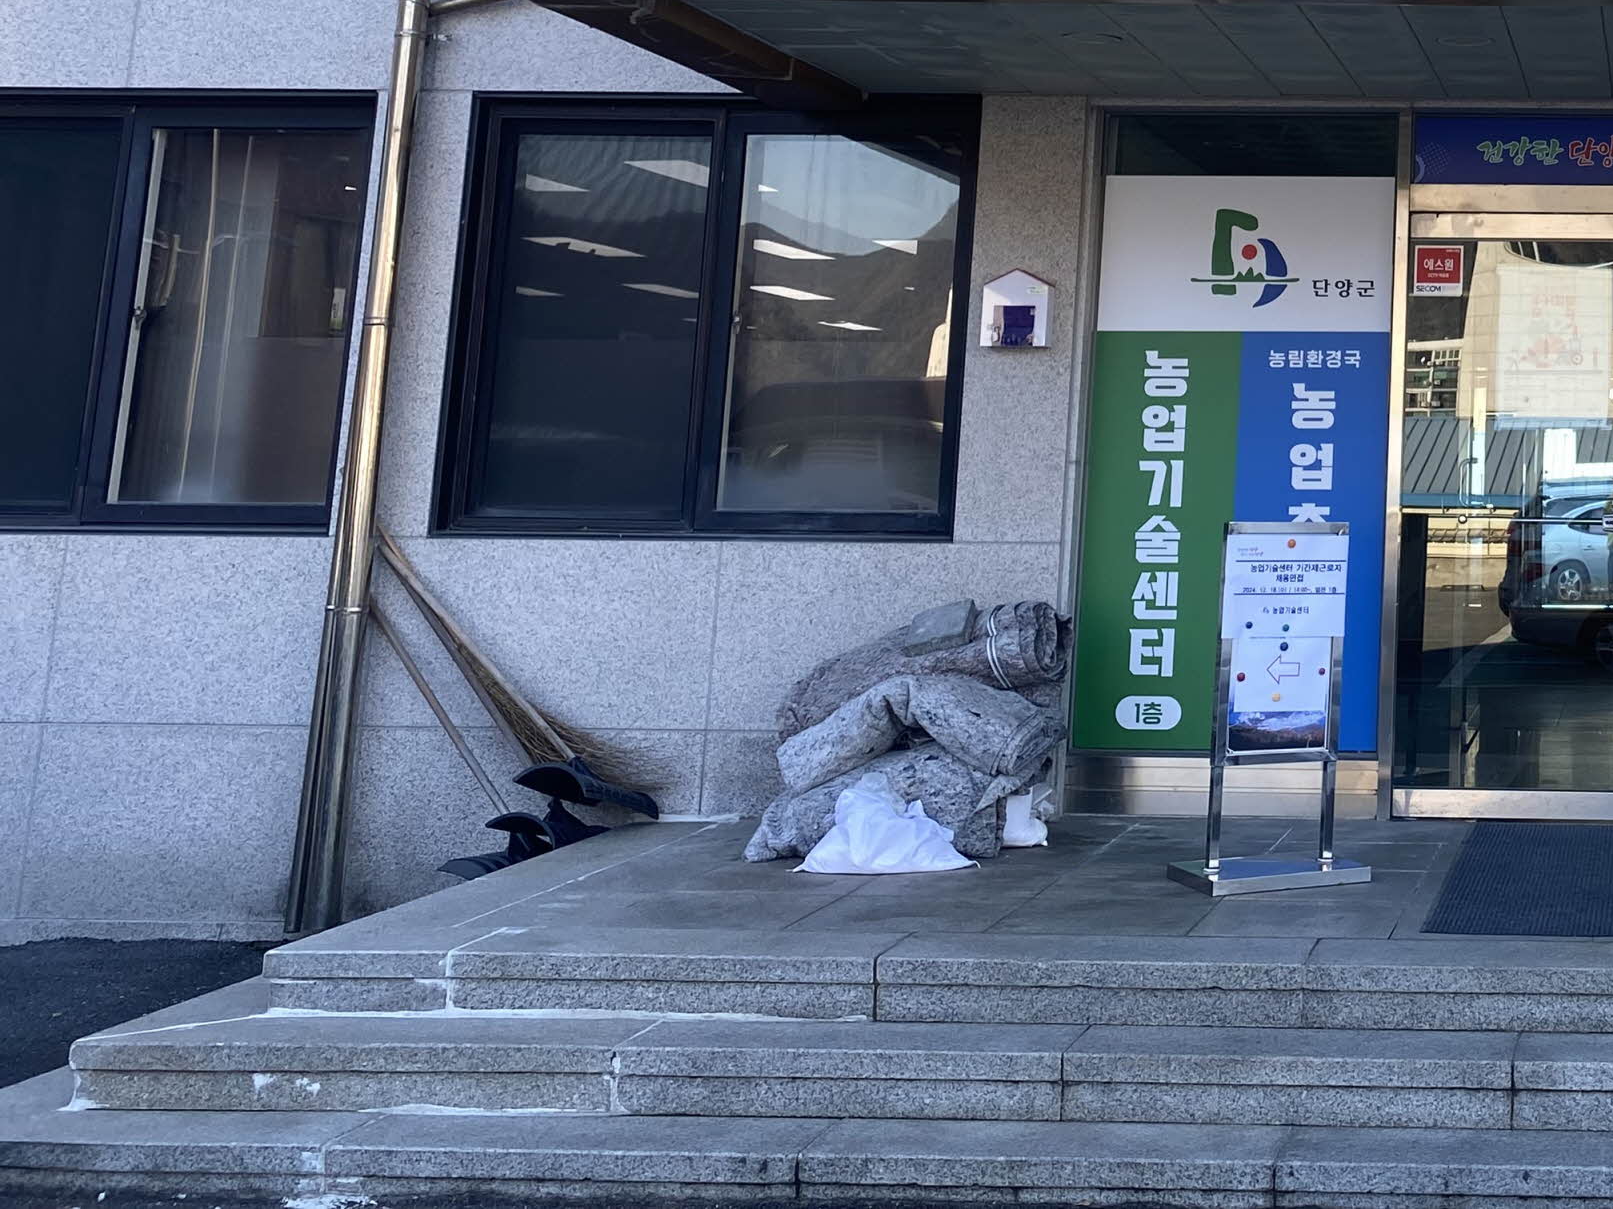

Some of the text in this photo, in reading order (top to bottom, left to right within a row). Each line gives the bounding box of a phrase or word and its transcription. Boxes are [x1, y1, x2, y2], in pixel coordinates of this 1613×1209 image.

[1477, 137, 1564, 166] 건강한
[1424, 258, 1453, 271] 에스원
[1312, 278, 1375, 298] 단양군
[1268, 349, 1361, 369] 농림환경국
[1129, 350, 1190, 677] 농업기술센터
[1251, 564, 1341, 573] 농업기술센터 기간제근로자
[1133, 701, 1163, 725] 1층
